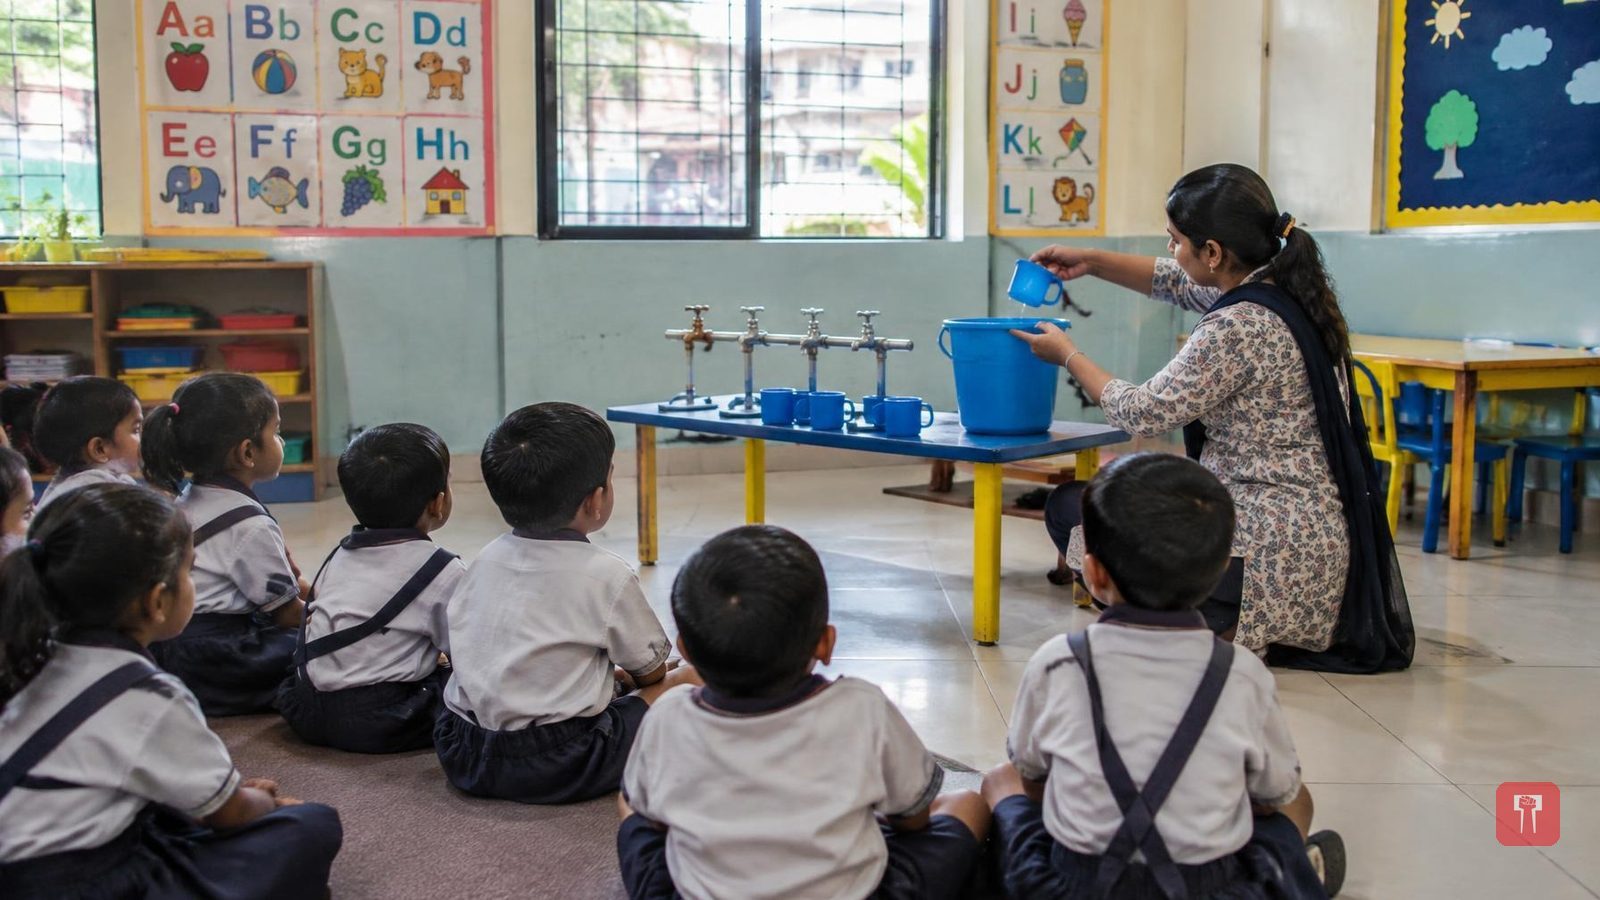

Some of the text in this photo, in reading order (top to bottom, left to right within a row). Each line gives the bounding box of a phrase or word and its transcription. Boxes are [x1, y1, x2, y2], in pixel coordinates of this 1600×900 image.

[156, 1, 215, 38] Aa
[245, 4, 300, 41] Bb
[330, 8, 384, 43] Cc
[413, 11, 467, 47] Dd
[1005, 63, 1037, 100] Jj
[161, 122, 217, 158] Ee
[250, 125, 297, 158] Ff
[332, 125, 387, 166] Gg
[416, 127, 469, 160] Hh
[1004, 123, 1042, 155] Kk
